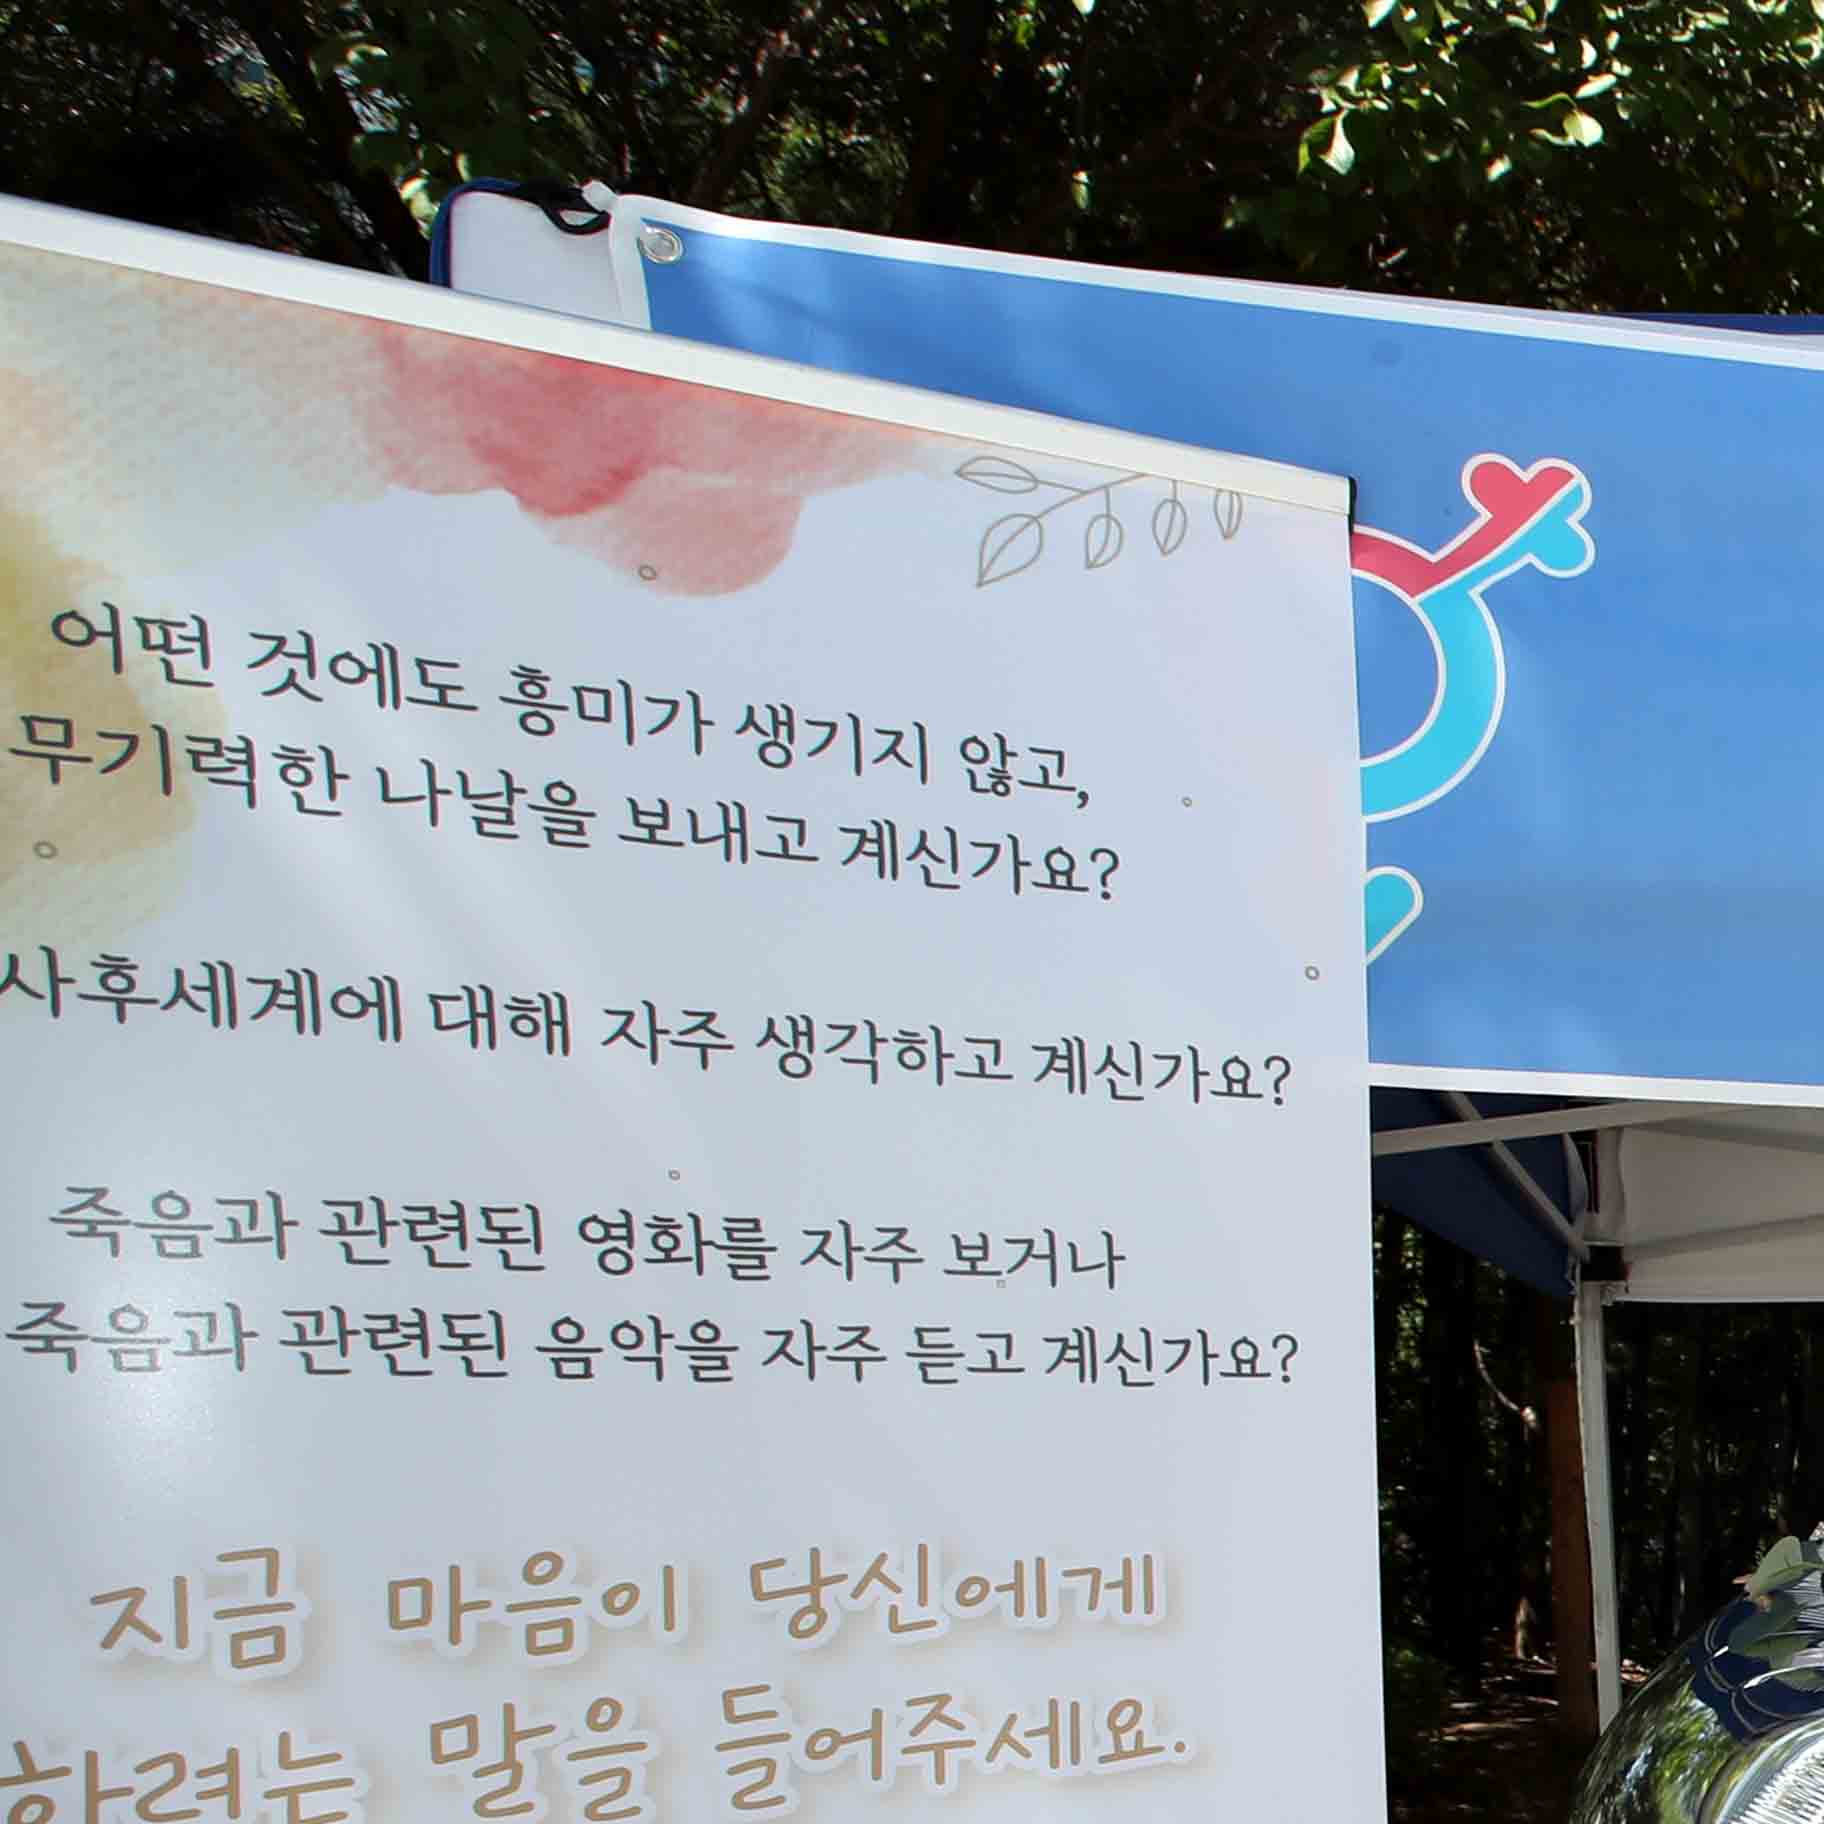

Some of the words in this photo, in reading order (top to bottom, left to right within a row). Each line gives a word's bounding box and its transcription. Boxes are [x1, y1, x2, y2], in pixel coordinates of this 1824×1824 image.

[51, 602, 213, 689] 어떤
[247, 625, 477, 714] 것에도
[499, 661, 713, 756] 흥미가
[735, 697, 931, 790] 생기지
[958, 728, 1091, 811] 않고,
[9, 710, 350, 818] 무기력한
[379, 756, 597, 847] 나날을
[618, 796, 818, 869] 보내고
[840, 816, 1120, 902] 계신가요?
[0, 944, 402, 1045] 사후세계에
[429, 978, 571, 1060] 대해
[600, 1000, 735, 1075] 자주
[755, 1010, 1013, 1088] 생각하고
[1032, 1034, 1292, 1109] 계신가요?
[50, 1186, 298, 1263] 죽음과
[318, 1194, 547, 1276] 관련된
[577, 1207, 778, 1281] 영화를
[800, 1220, 924, 1285] 자주
[943, 1221, 1126, 1291] 보거나
[5, 1298, 260, 1378] 죽음과
[279, 1304, 508, 1380] 관련된
[533, 1313, 740, 1384] 음악을
[761, 1317, 888, 1384] 자주
[905, 1324, 1026, 1384] 듣고
[1042, 1324, 1299, 1388] 계신가요?
[90, 1546, 299, 1671] 지금
[386, 1549, 679, 1657] 마음이
[749, 1540, 1159, 1639] 당신에게
[429, 1694, 648, 1823] 말을
[715, 1681, 1189, 1812] 들어주세요.
